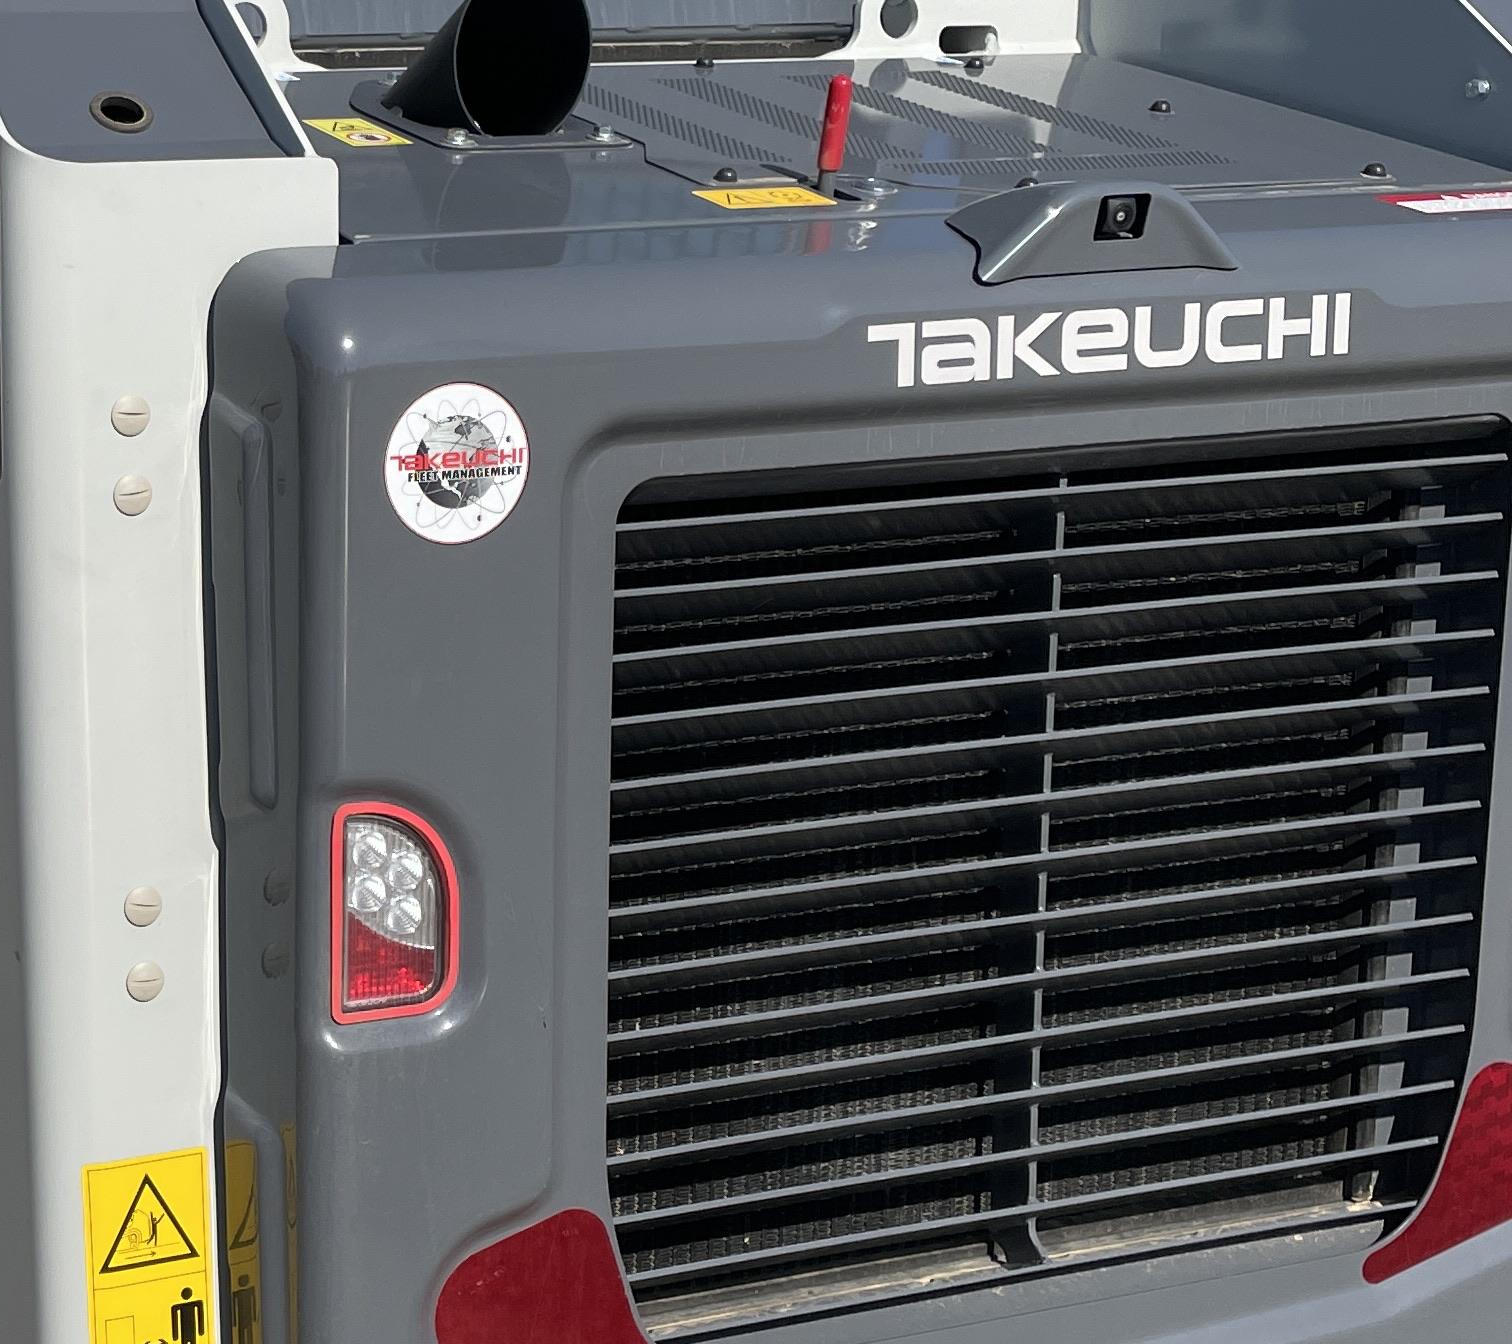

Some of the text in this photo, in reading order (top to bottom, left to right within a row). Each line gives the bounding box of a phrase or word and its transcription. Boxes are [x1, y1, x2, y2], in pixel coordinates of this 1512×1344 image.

[867, 292, 1352, 388] TAKEUCHI
[390, 447, 525, 472] TAKEUCHI
[408, 465, 522, 483] FLEET MANAGEMENT
